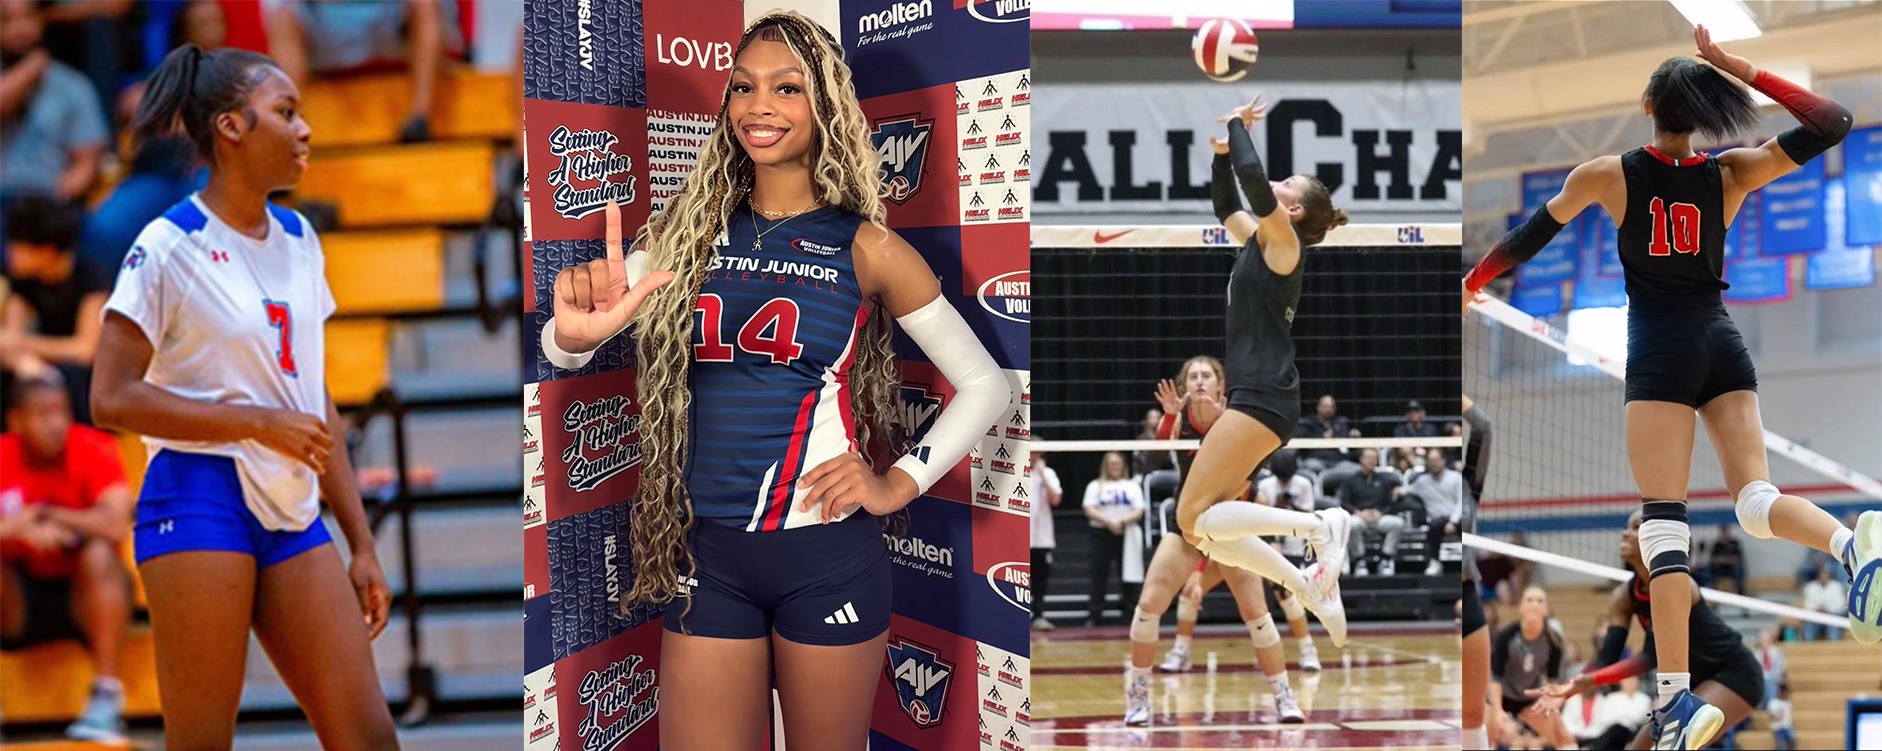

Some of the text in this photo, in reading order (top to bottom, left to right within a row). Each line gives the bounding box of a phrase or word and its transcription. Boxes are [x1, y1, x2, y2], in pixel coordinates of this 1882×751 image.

[857, 22, 934, 48] For the real game
[858, 0, 934, 34] molten
[656, 33, 733, 72] LOVB
[647, 109, 695, 122] AUSTIN
[647, 122, 696, 134] AUSTIN
[549, 125, 618, 154] Setting
[648, 136, 697, 147] AUSTIN
[648, 149, 697, 160] AUSTIN
[877, 131, 928, 172] AJV
[548, 150, 631, 186] A Higher
[1033, 130, 1212, 201] ALL
[553, 175, 636, 211] Standard
[1649, 196, 1701, 256] 10
[761, 260, 839, 284] JUNIOR
[1005, 298, 1030, 313] VOL
[262, 299, 298, 378] 7
[693, 291, 804, 366] 14
[563, 394, 630, 432] Setting
[562, 429, 585, 463] A
[892, 556, 954, 579] the real game
[1005, 567, 1030, 586] AUS
[578, 655, 643, 705] Setting
[895, 657, 949, 697] AJV
[578, 669, 656, 737] A Higher
[583, 686, 659, 751] Standard
